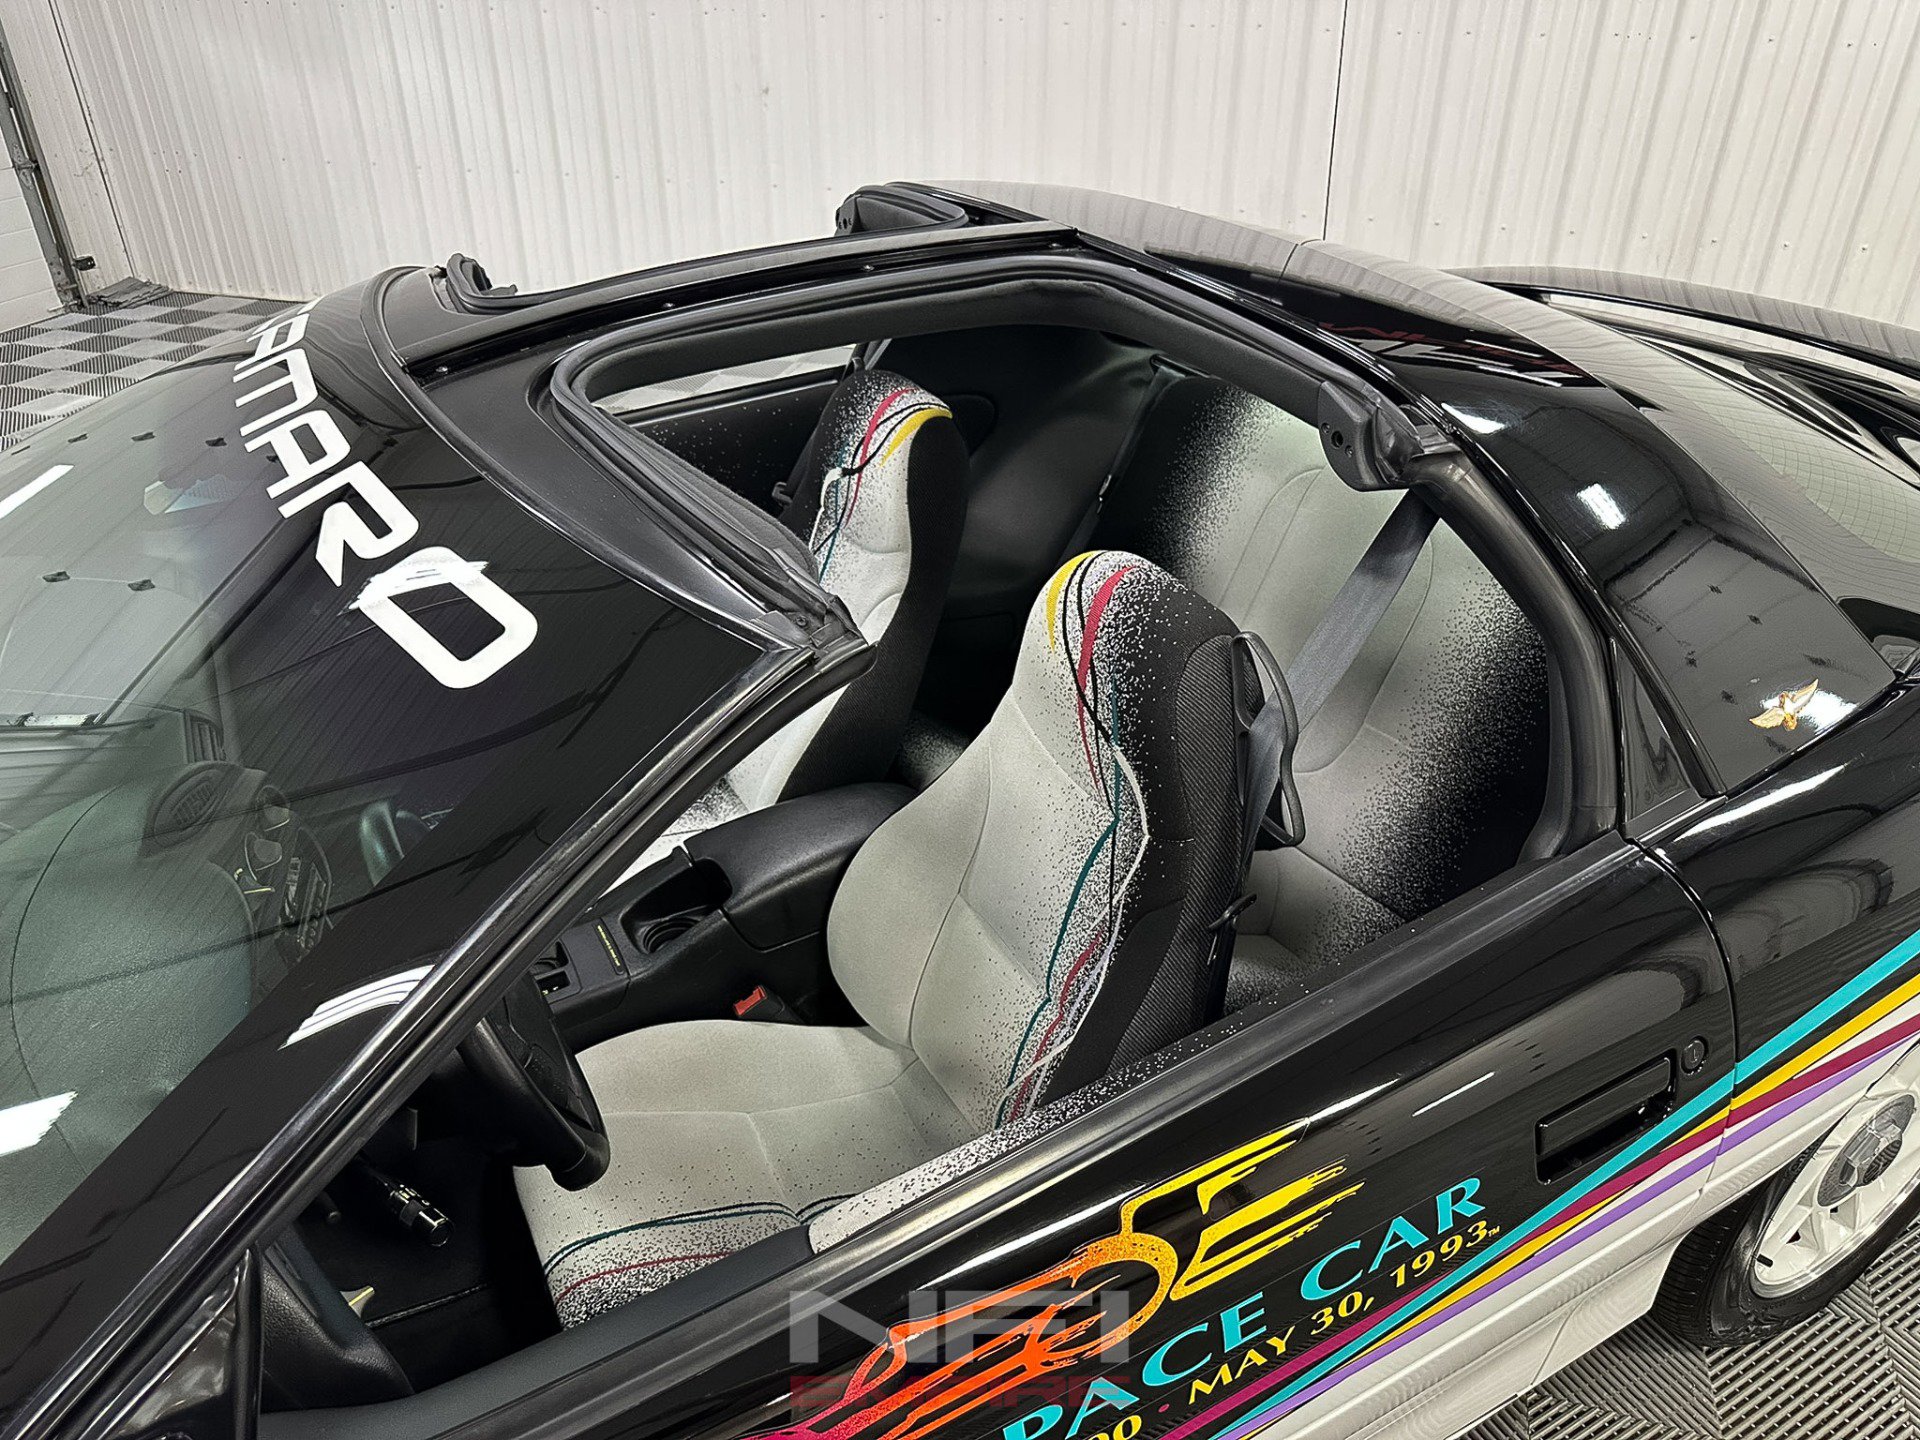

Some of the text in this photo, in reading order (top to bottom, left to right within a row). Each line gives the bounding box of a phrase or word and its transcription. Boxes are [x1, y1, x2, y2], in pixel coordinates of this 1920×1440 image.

[232, 294, 538, 690] AMARO
[1299, 1177, 1487, 1301] CAR
[1188, 1325, 1296, 1406] MAY
[1310, 1290, 1376, 1336] 30,
